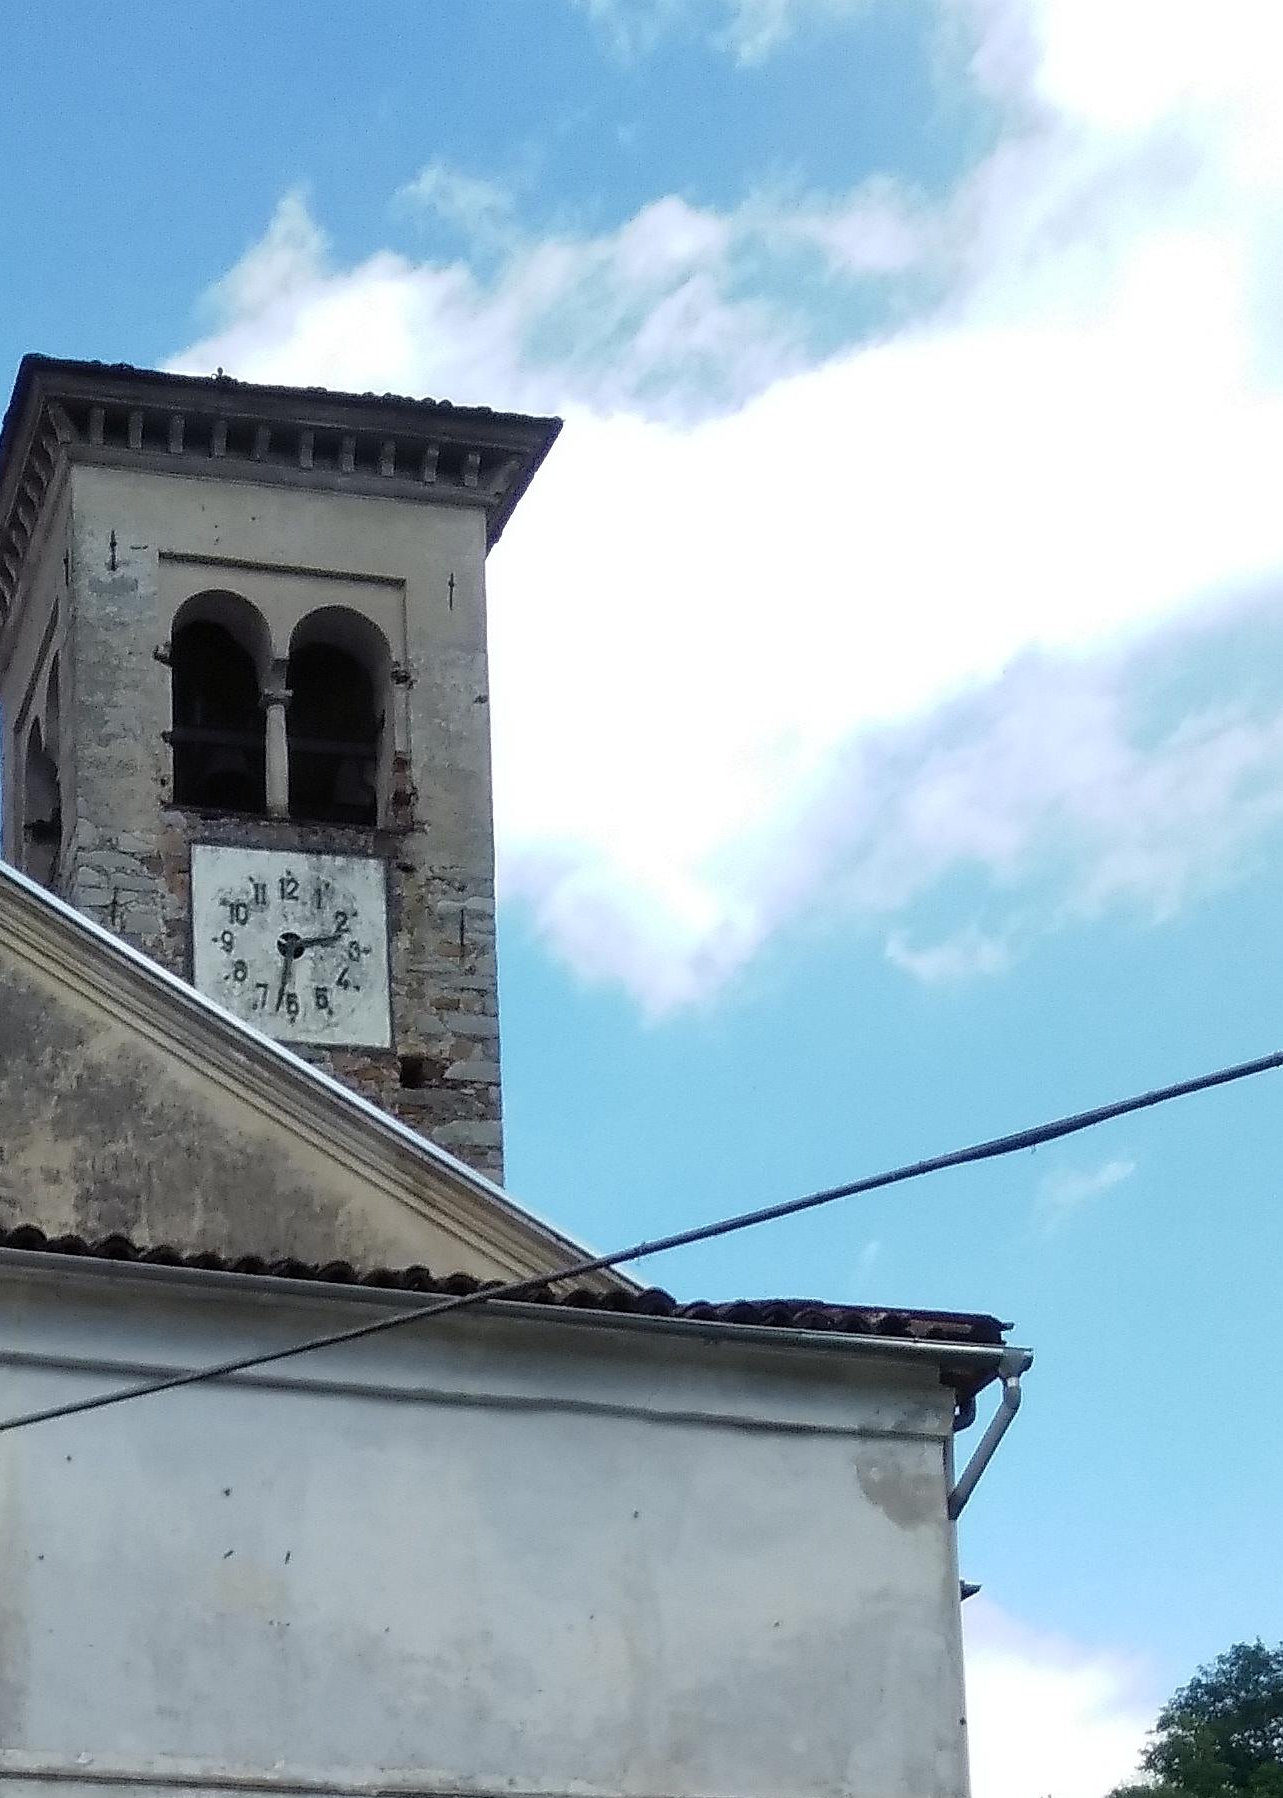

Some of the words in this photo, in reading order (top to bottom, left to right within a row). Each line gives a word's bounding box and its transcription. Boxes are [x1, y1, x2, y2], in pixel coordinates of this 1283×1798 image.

[254, 884, 267, 905] 11
[279, 877, 300, 901] 12
[229, 902, 249, 925] 10
[334, 911, 350, 934] 2
[220, 930, 234, 954] 9
[233, 959, 248, 982] 8
[336, 967, 351, 990] 4
[255, 983, 269, 1009] 7
[286, 993, 299, 1016] 6
[315, 987, 329, 1009] 5
